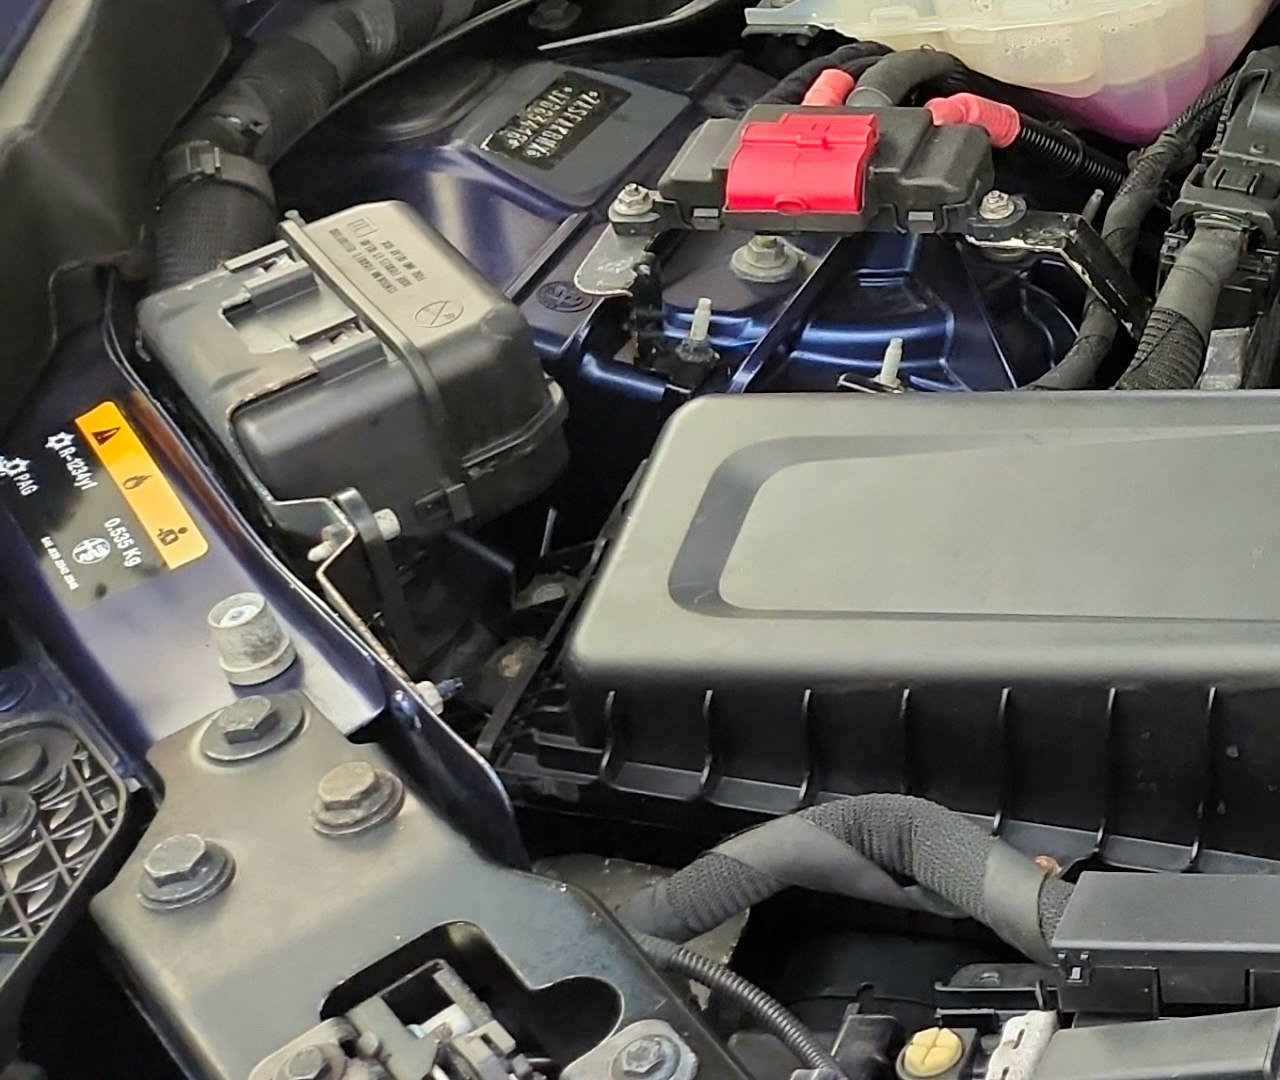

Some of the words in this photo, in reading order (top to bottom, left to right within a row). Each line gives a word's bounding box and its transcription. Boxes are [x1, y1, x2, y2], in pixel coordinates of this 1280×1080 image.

[13, 472, 40, 497] PAG
[104, 517, 135, 549] 0.535
[122, 546, 144, 568] Kg
